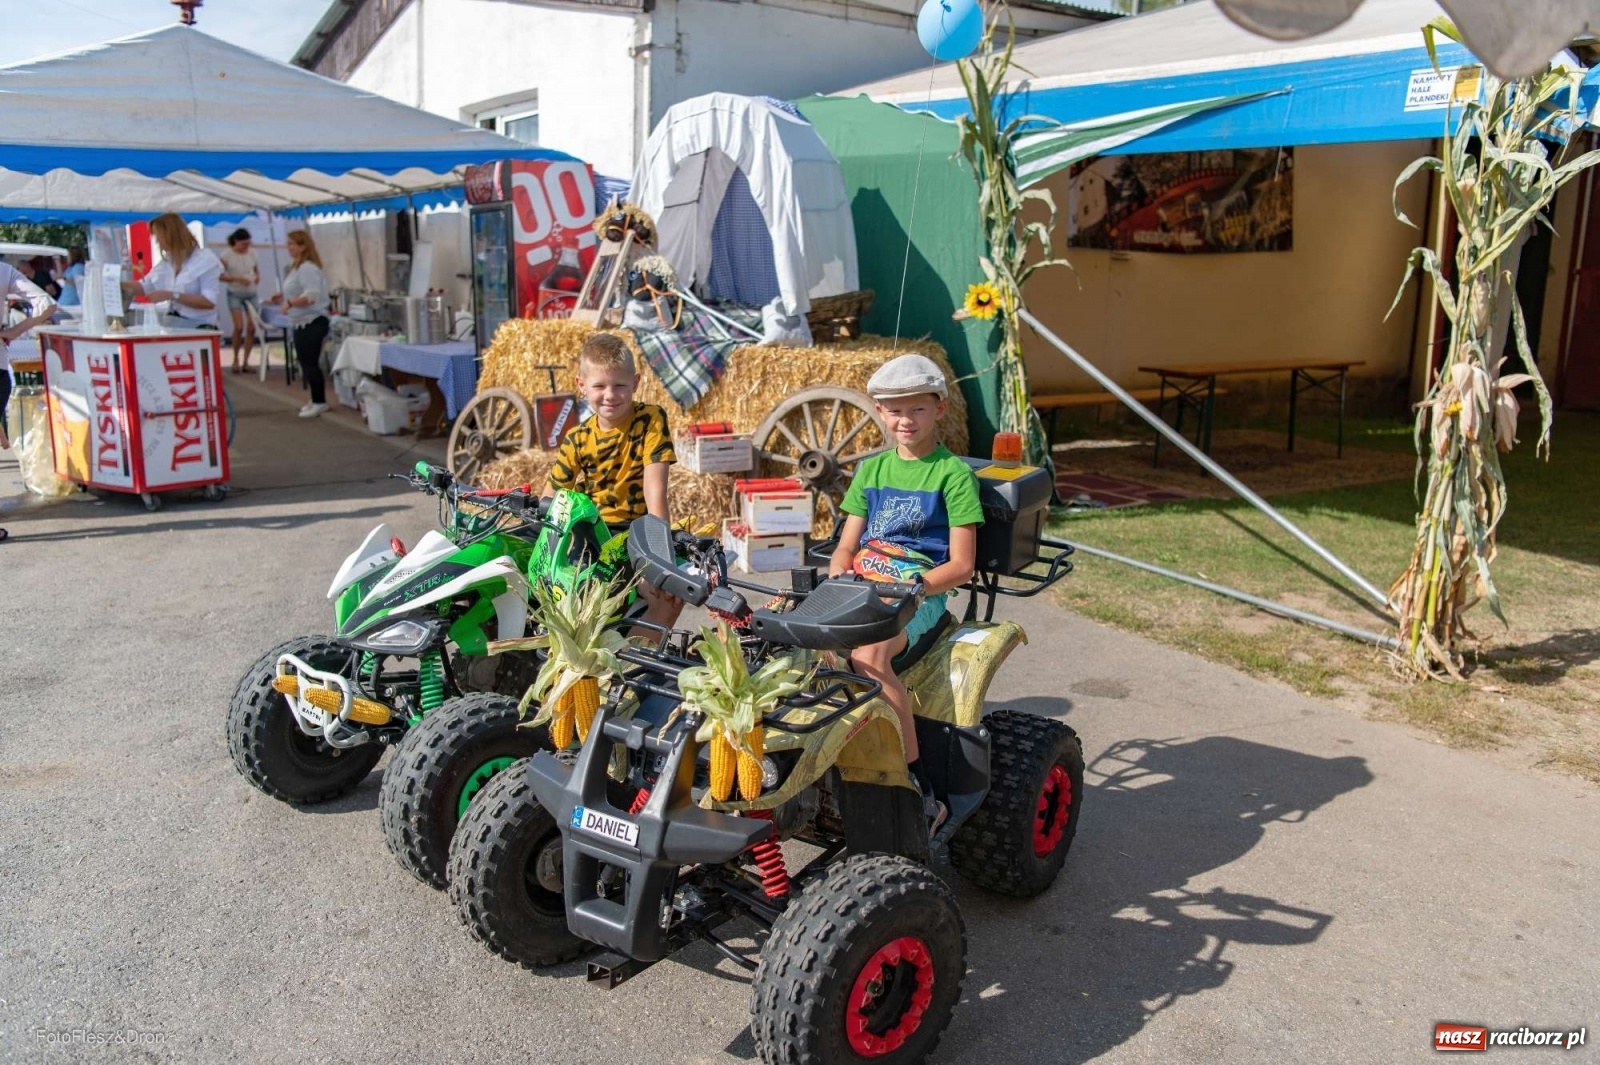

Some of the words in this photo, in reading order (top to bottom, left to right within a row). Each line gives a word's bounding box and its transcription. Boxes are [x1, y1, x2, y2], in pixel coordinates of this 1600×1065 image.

[1409, 94, 1449, 103] PLANDEKI
[87, 353, 118, 473] TYSKIE
[161, 350, 204, 472] TYSKIE
[586, 812, 632, 842] DANIEL
